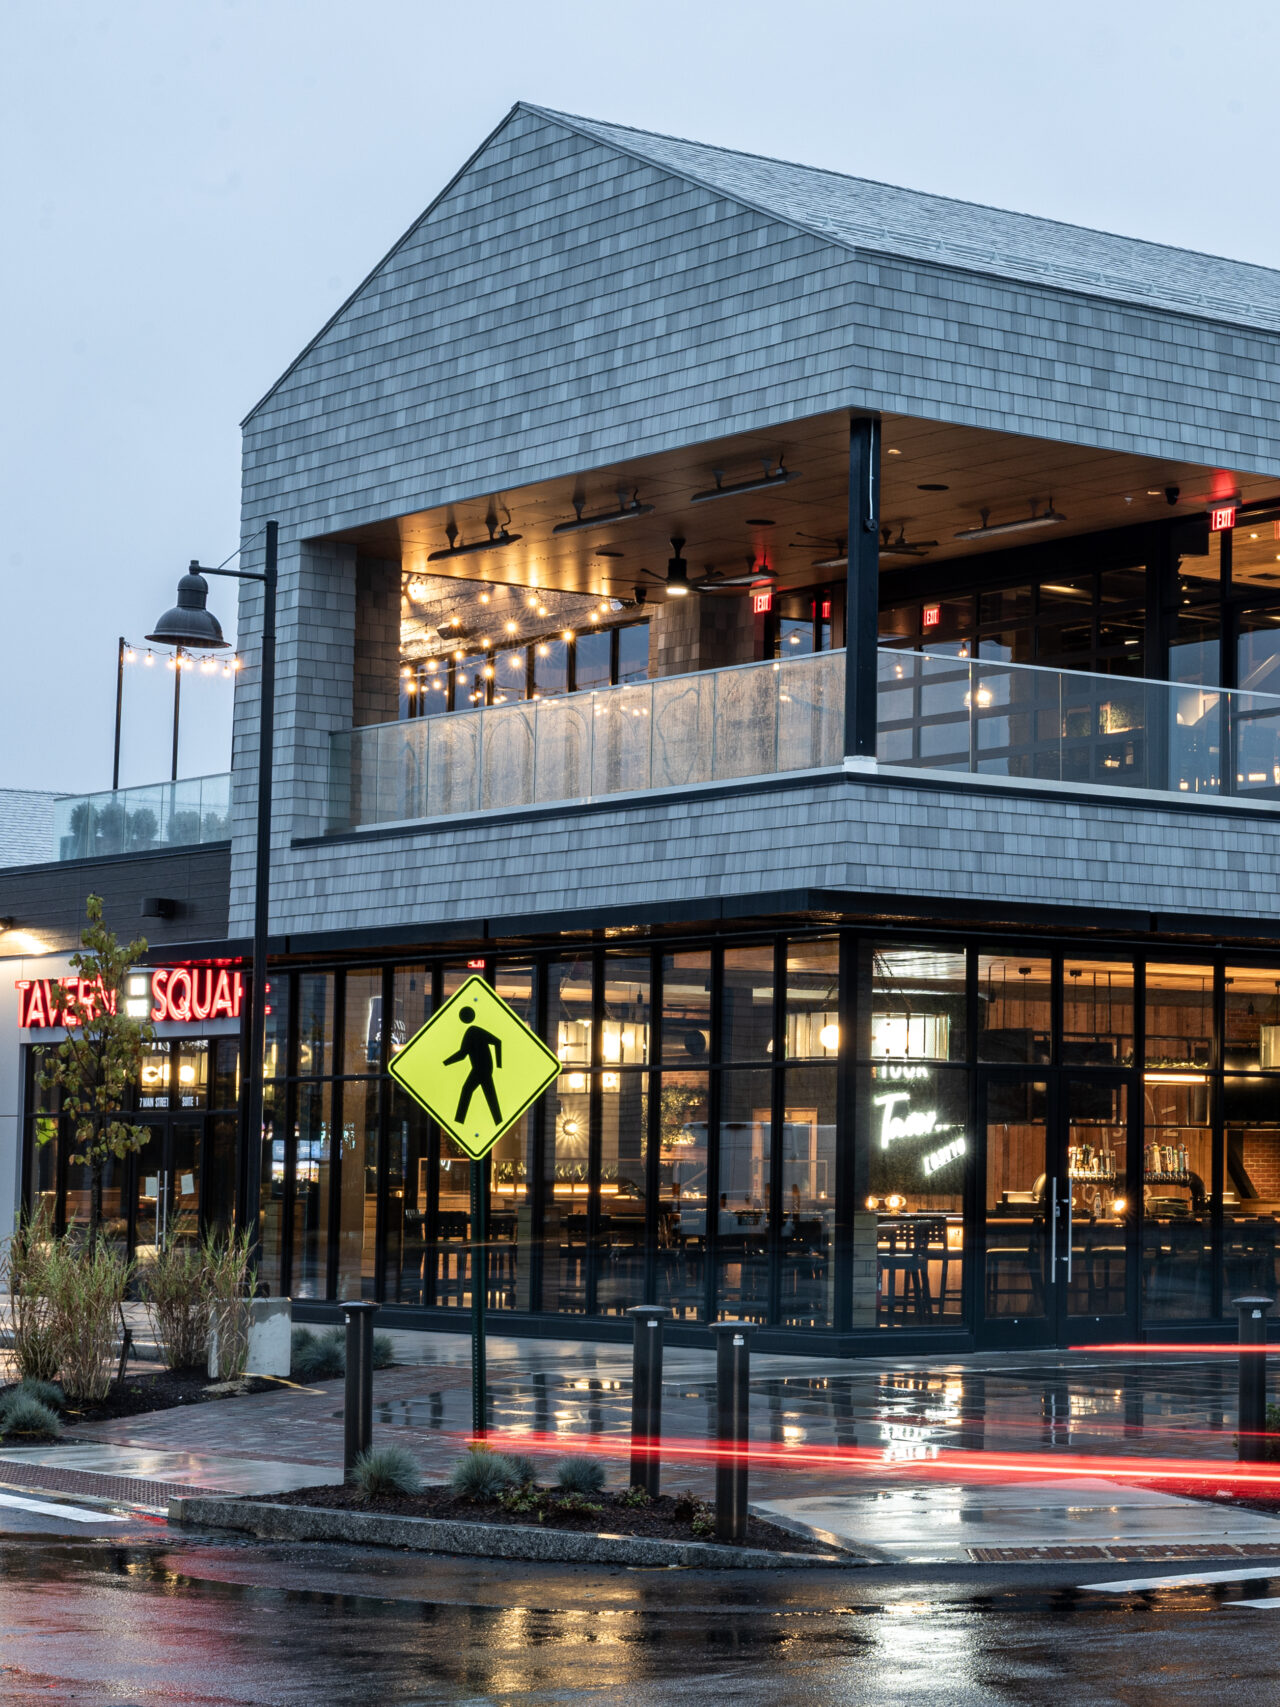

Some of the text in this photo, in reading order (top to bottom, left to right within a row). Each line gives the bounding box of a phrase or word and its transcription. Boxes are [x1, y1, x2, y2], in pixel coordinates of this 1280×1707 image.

[1216, 509, 1233, 529] EXIT
[756, 594, 770, 612] EXIT
[926, 607, 939, 625] EXIT
[150, 967, 271, 1022] SQUA
